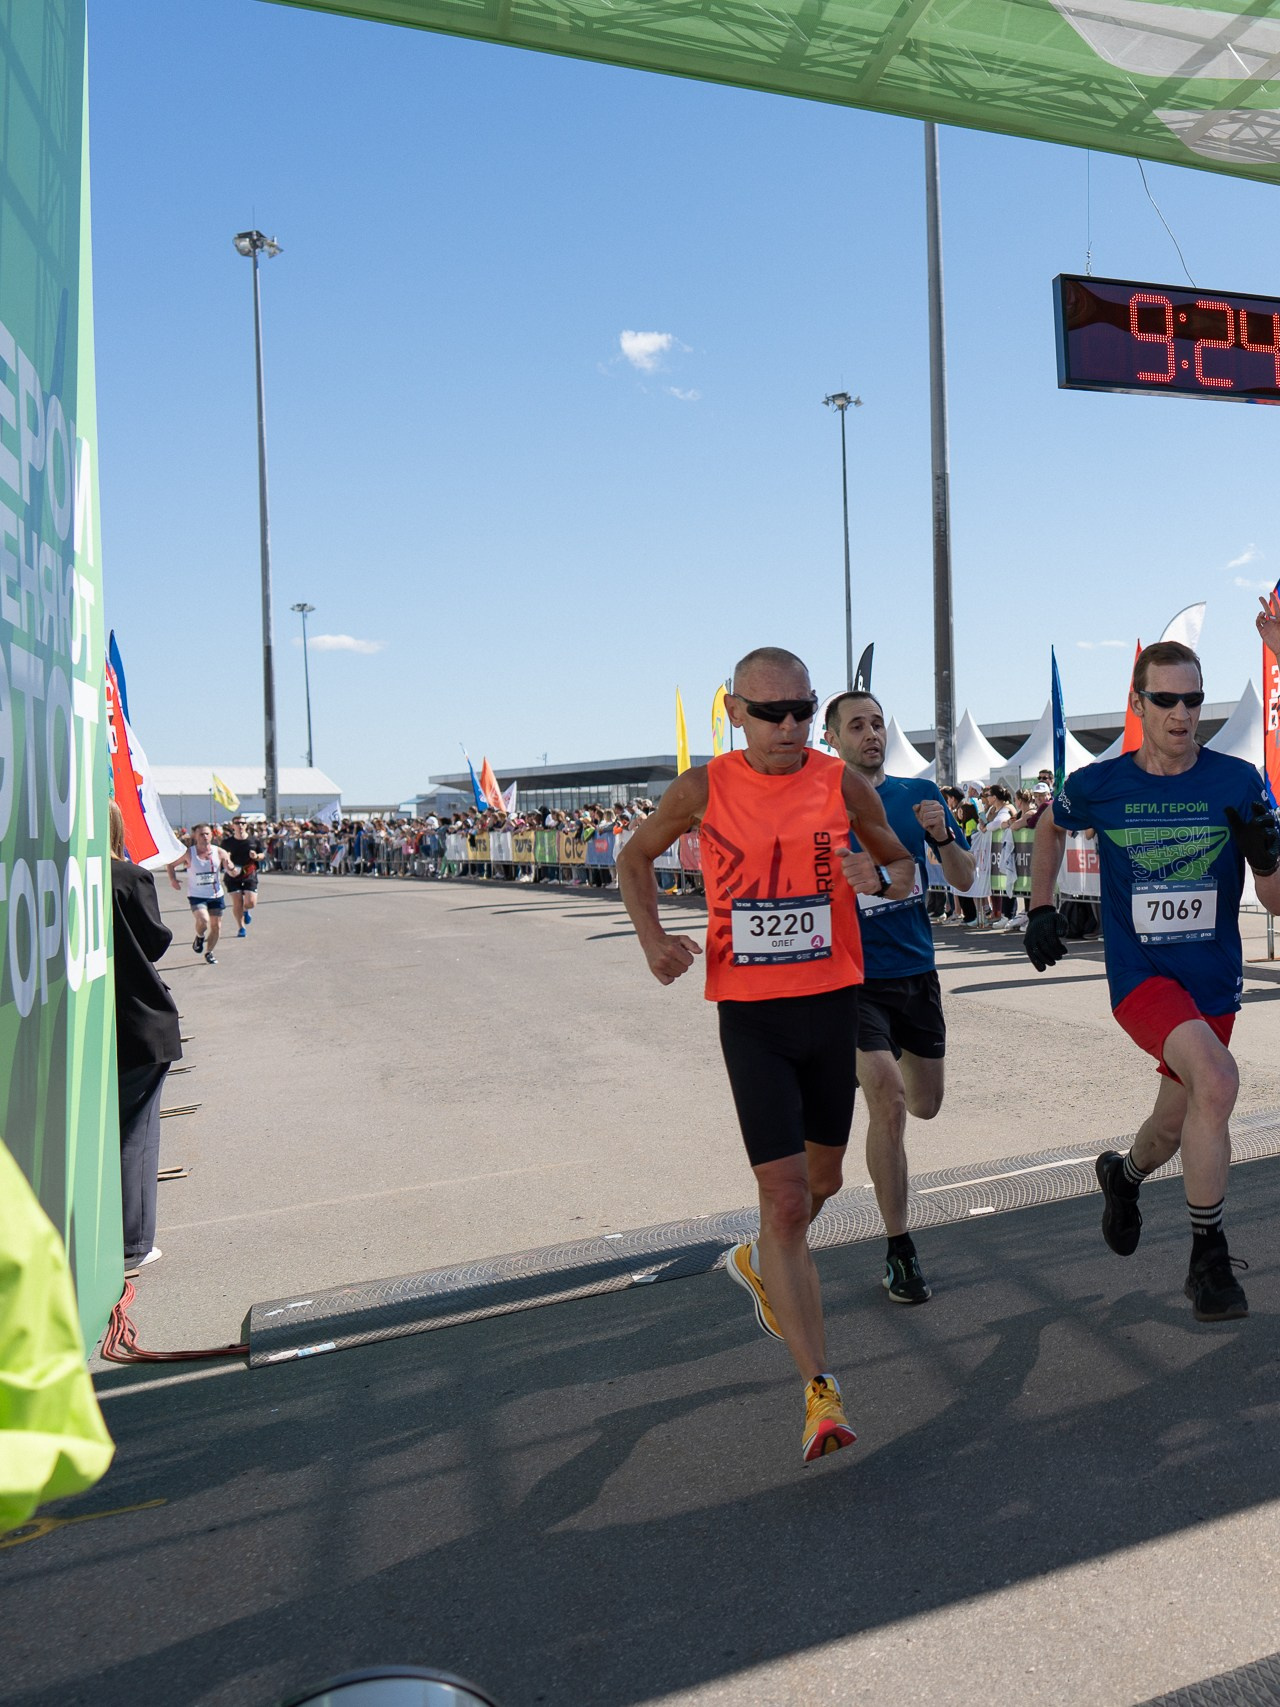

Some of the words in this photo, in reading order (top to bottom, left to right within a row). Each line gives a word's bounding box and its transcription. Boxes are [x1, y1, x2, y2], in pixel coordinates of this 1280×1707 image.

[1124, 803, 1160, 814] БЕГИ,
[1161, 800, 1209, 813] ГЕРОЙ!
[1124, 826, 1211, 847] ГЕРОИ
[1126, 844, 1211, 860] МЕНЯЮТ
[814, 832, 834, 902] RONG
[1131, 857, 1212, 879] ЭТОТ
[1147, 898, 1203, 921] 7069
[749, 911, 815, 937] 3220
[0, 855, 107, 1018] ОРОД
[771, 938, 795, 948] ОЛЕГ
